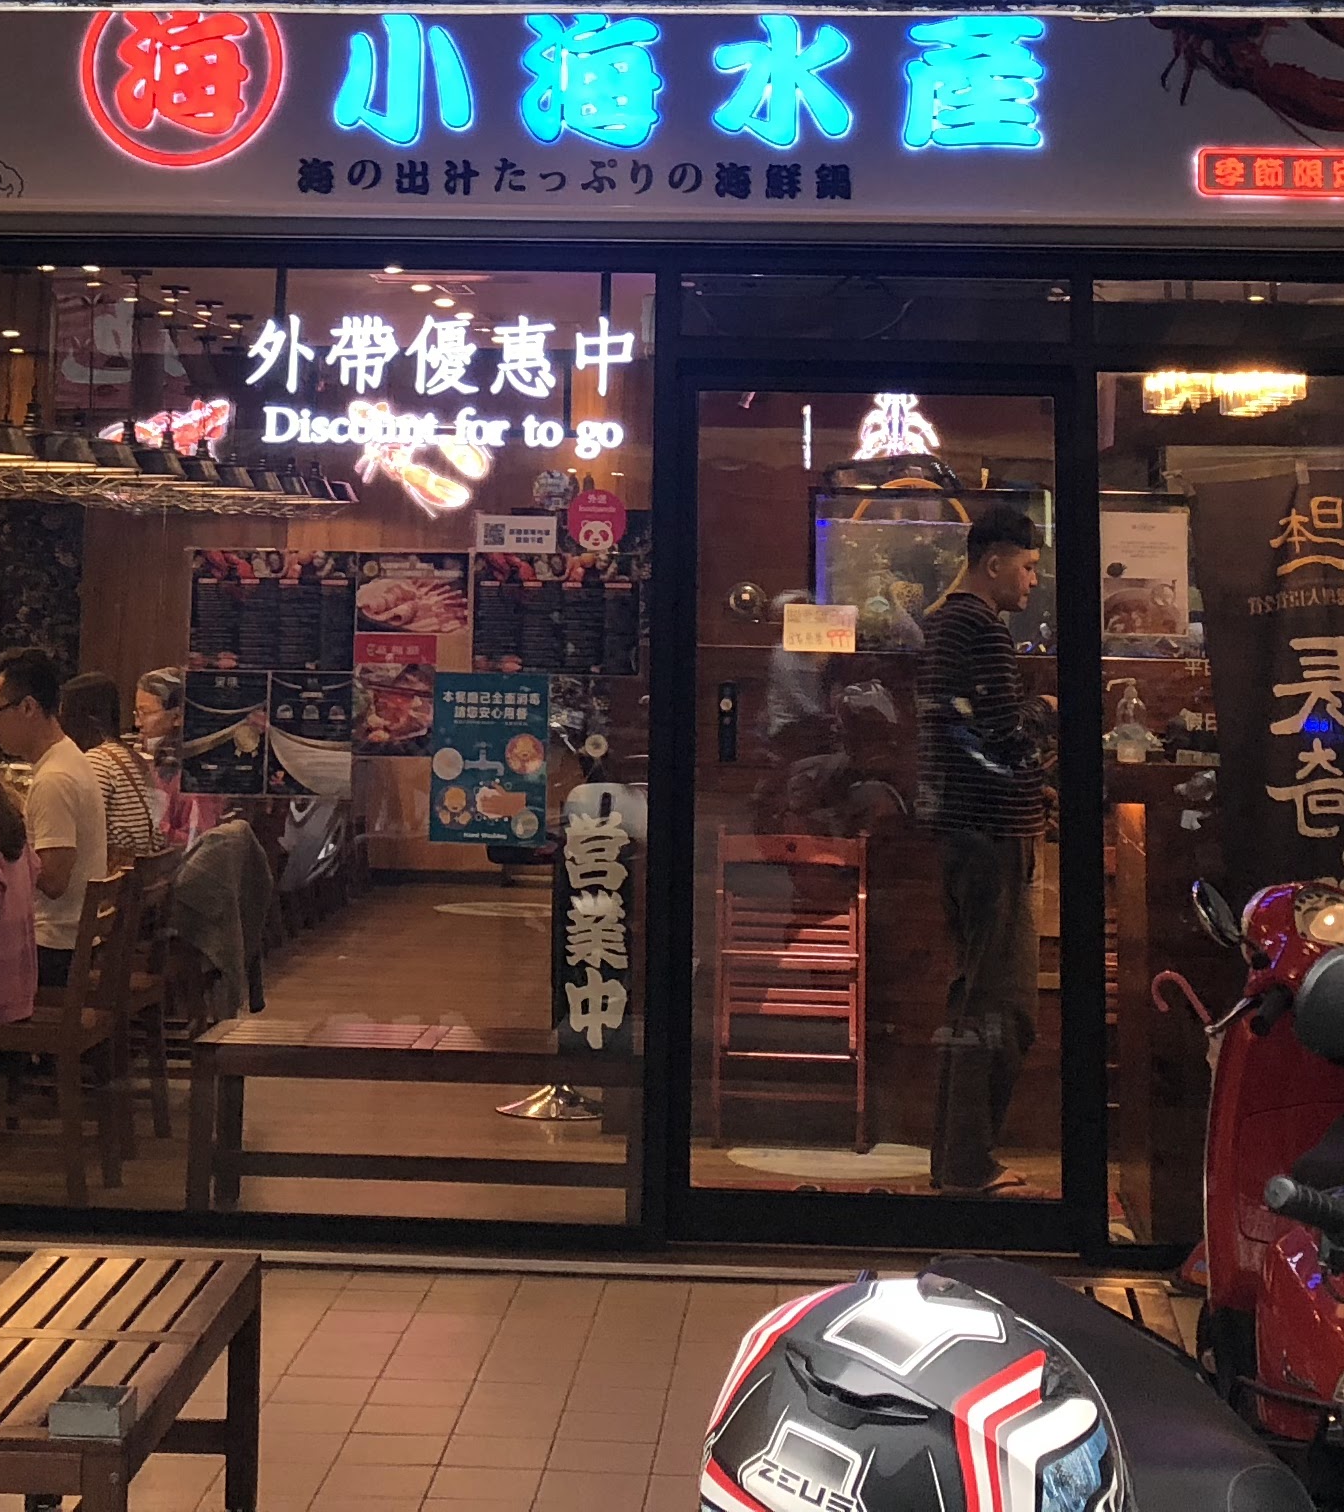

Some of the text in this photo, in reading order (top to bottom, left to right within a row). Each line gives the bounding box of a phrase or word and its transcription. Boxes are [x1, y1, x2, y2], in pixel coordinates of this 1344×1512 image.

[115, 13, 250, 136] 海
[297, 157, 853, 200] 海の出汁たっぷりの海鮮鍋
[245, 313, 636, 399] 外帶優惠中
[261, 404, 625, 460] Discount for to go
[757, 1457, 856, 1512] ZEUS
